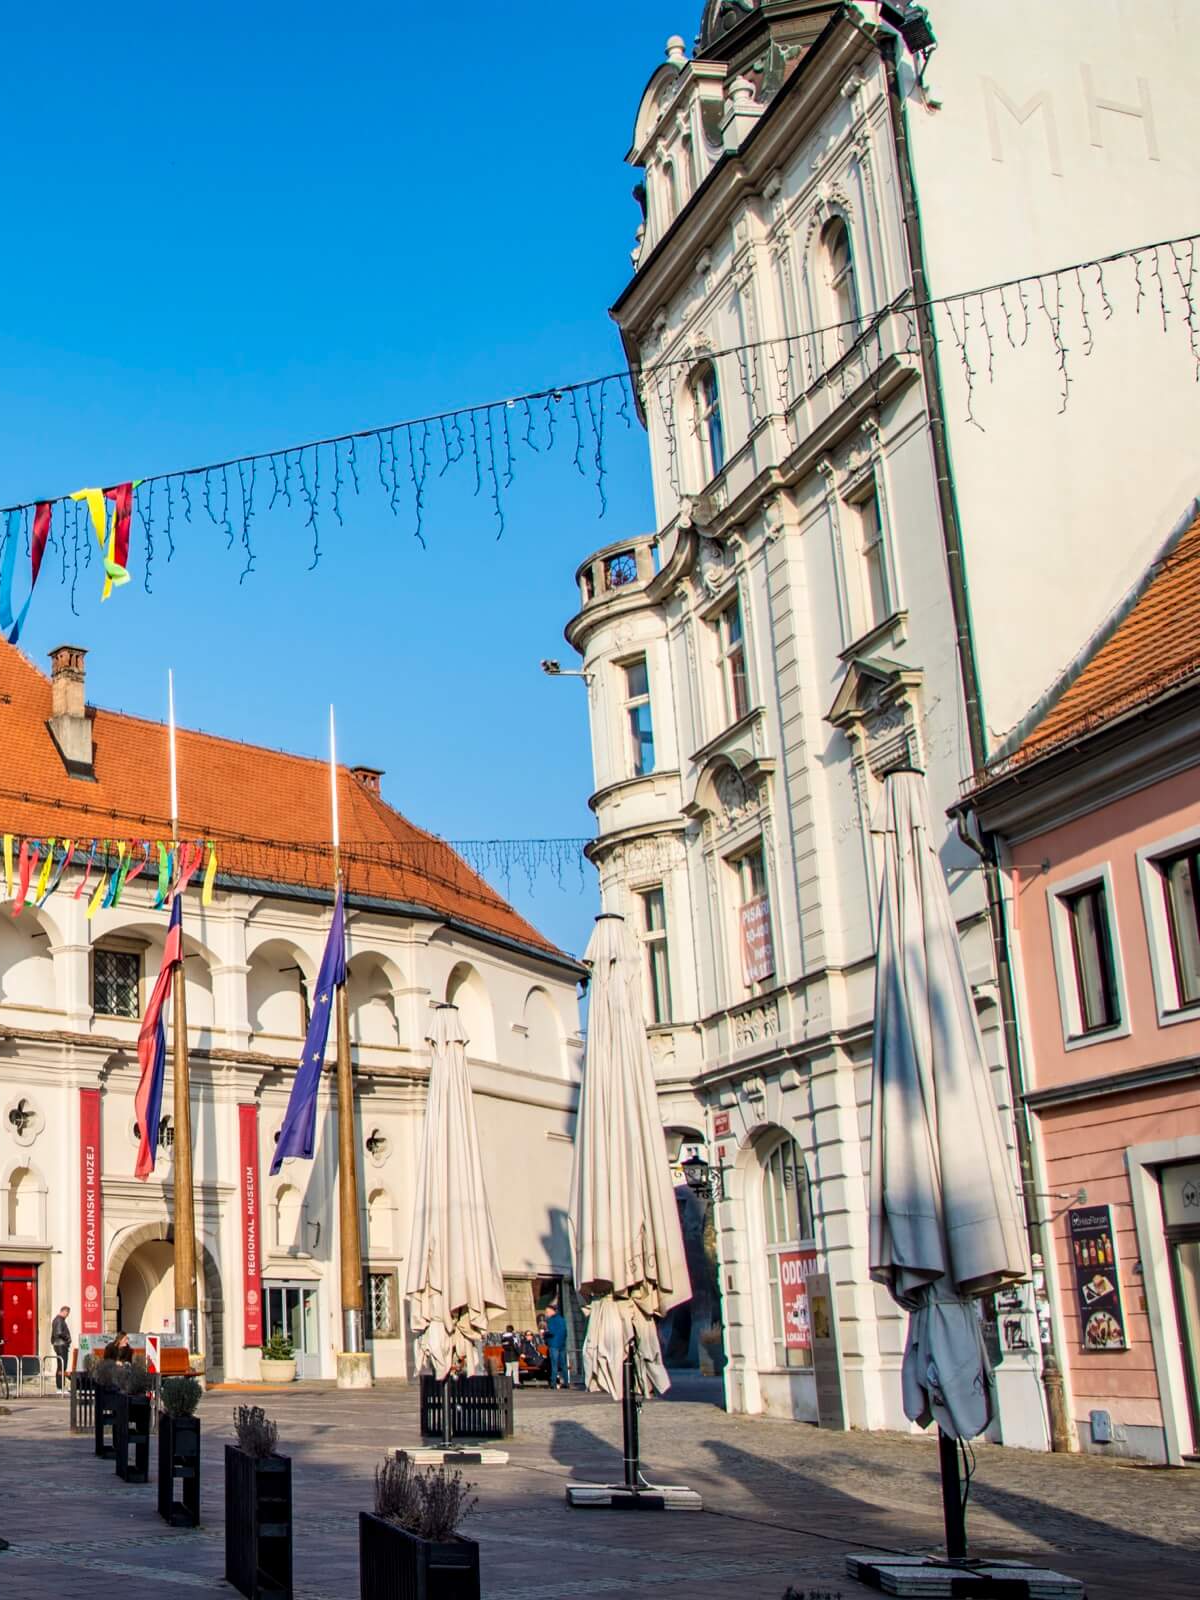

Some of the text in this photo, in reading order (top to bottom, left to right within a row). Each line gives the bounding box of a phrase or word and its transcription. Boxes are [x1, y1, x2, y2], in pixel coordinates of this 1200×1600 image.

[86, 1145, 96, 1271] POKRAJINSKI MUZEJ
[246, 1167, 256, 1276] REGIONAL MUSEUM
